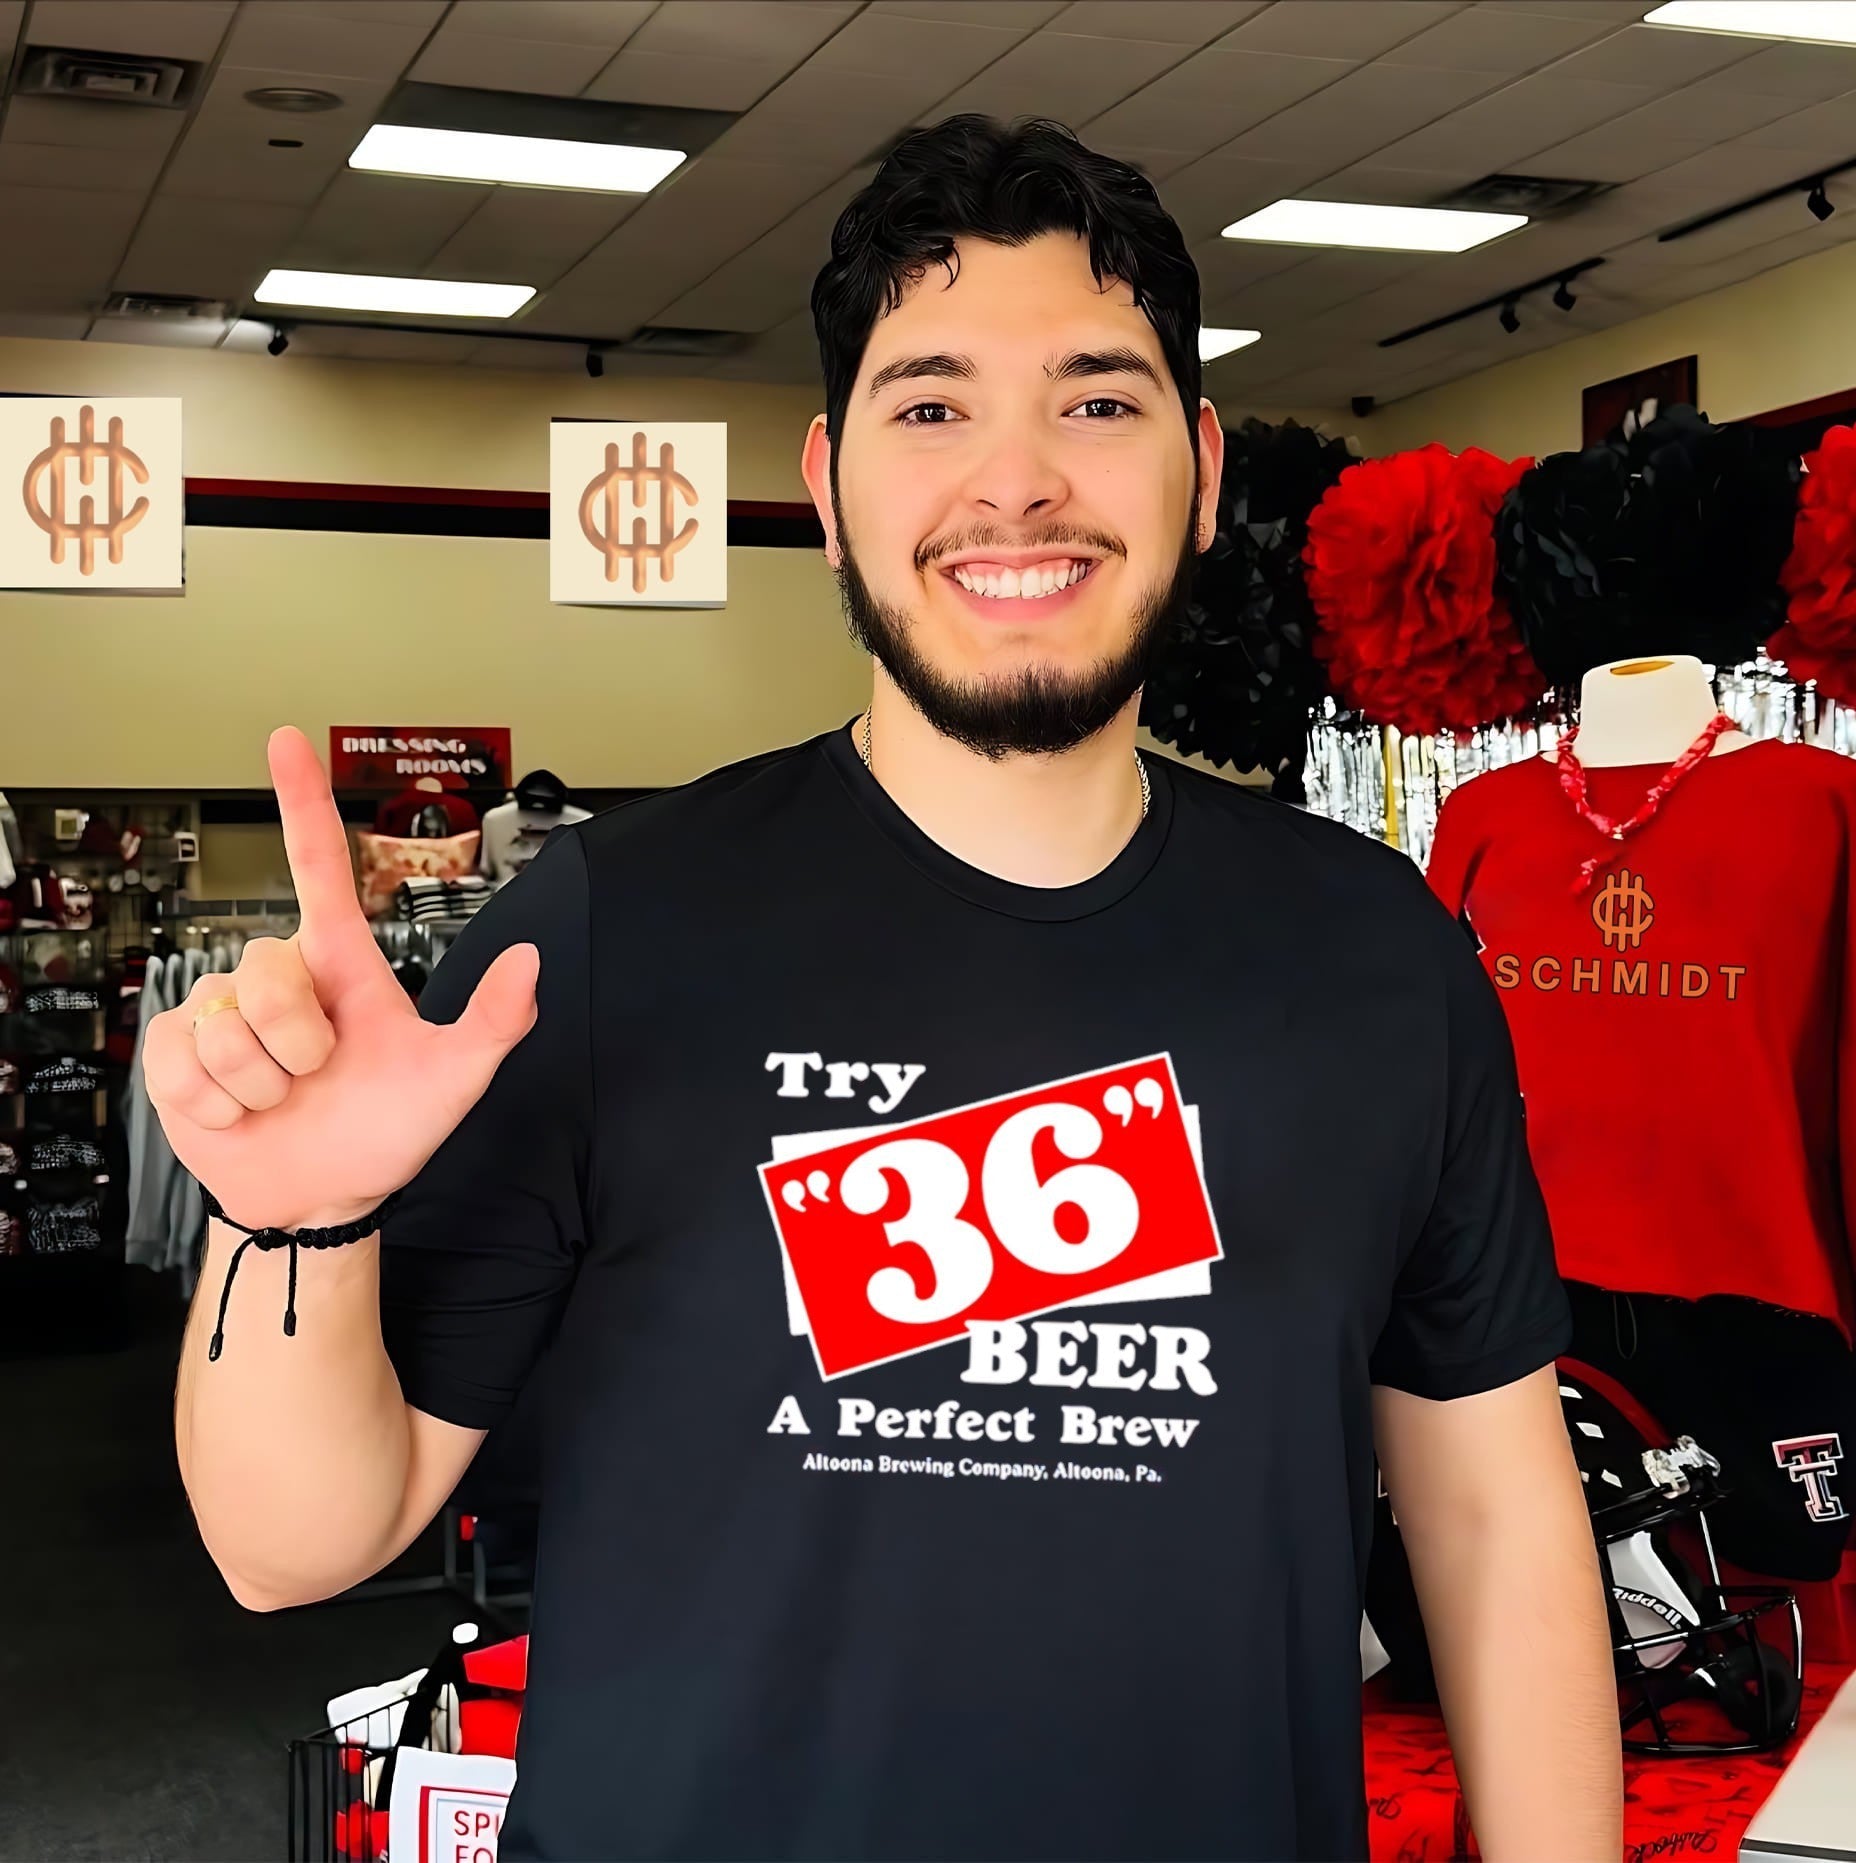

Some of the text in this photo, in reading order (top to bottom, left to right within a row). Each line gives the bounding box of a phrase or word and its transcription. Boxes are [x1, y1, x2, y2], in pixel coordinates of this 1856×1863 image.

[342, 737, 467, 754] DRESSING
[396, 758, 488, 775] ROOMS
[1494, 953, 1747, 1000] SCHMIDT
[764, 1052, 926, 1114] Try
[960, 1320, 1218, 1396] BEER
[767, 1395, 1200, 1448] A Perfect Brew
[803, 1453, 1163, 1483] Altoona Brewing Company, Altoona, Pa.
